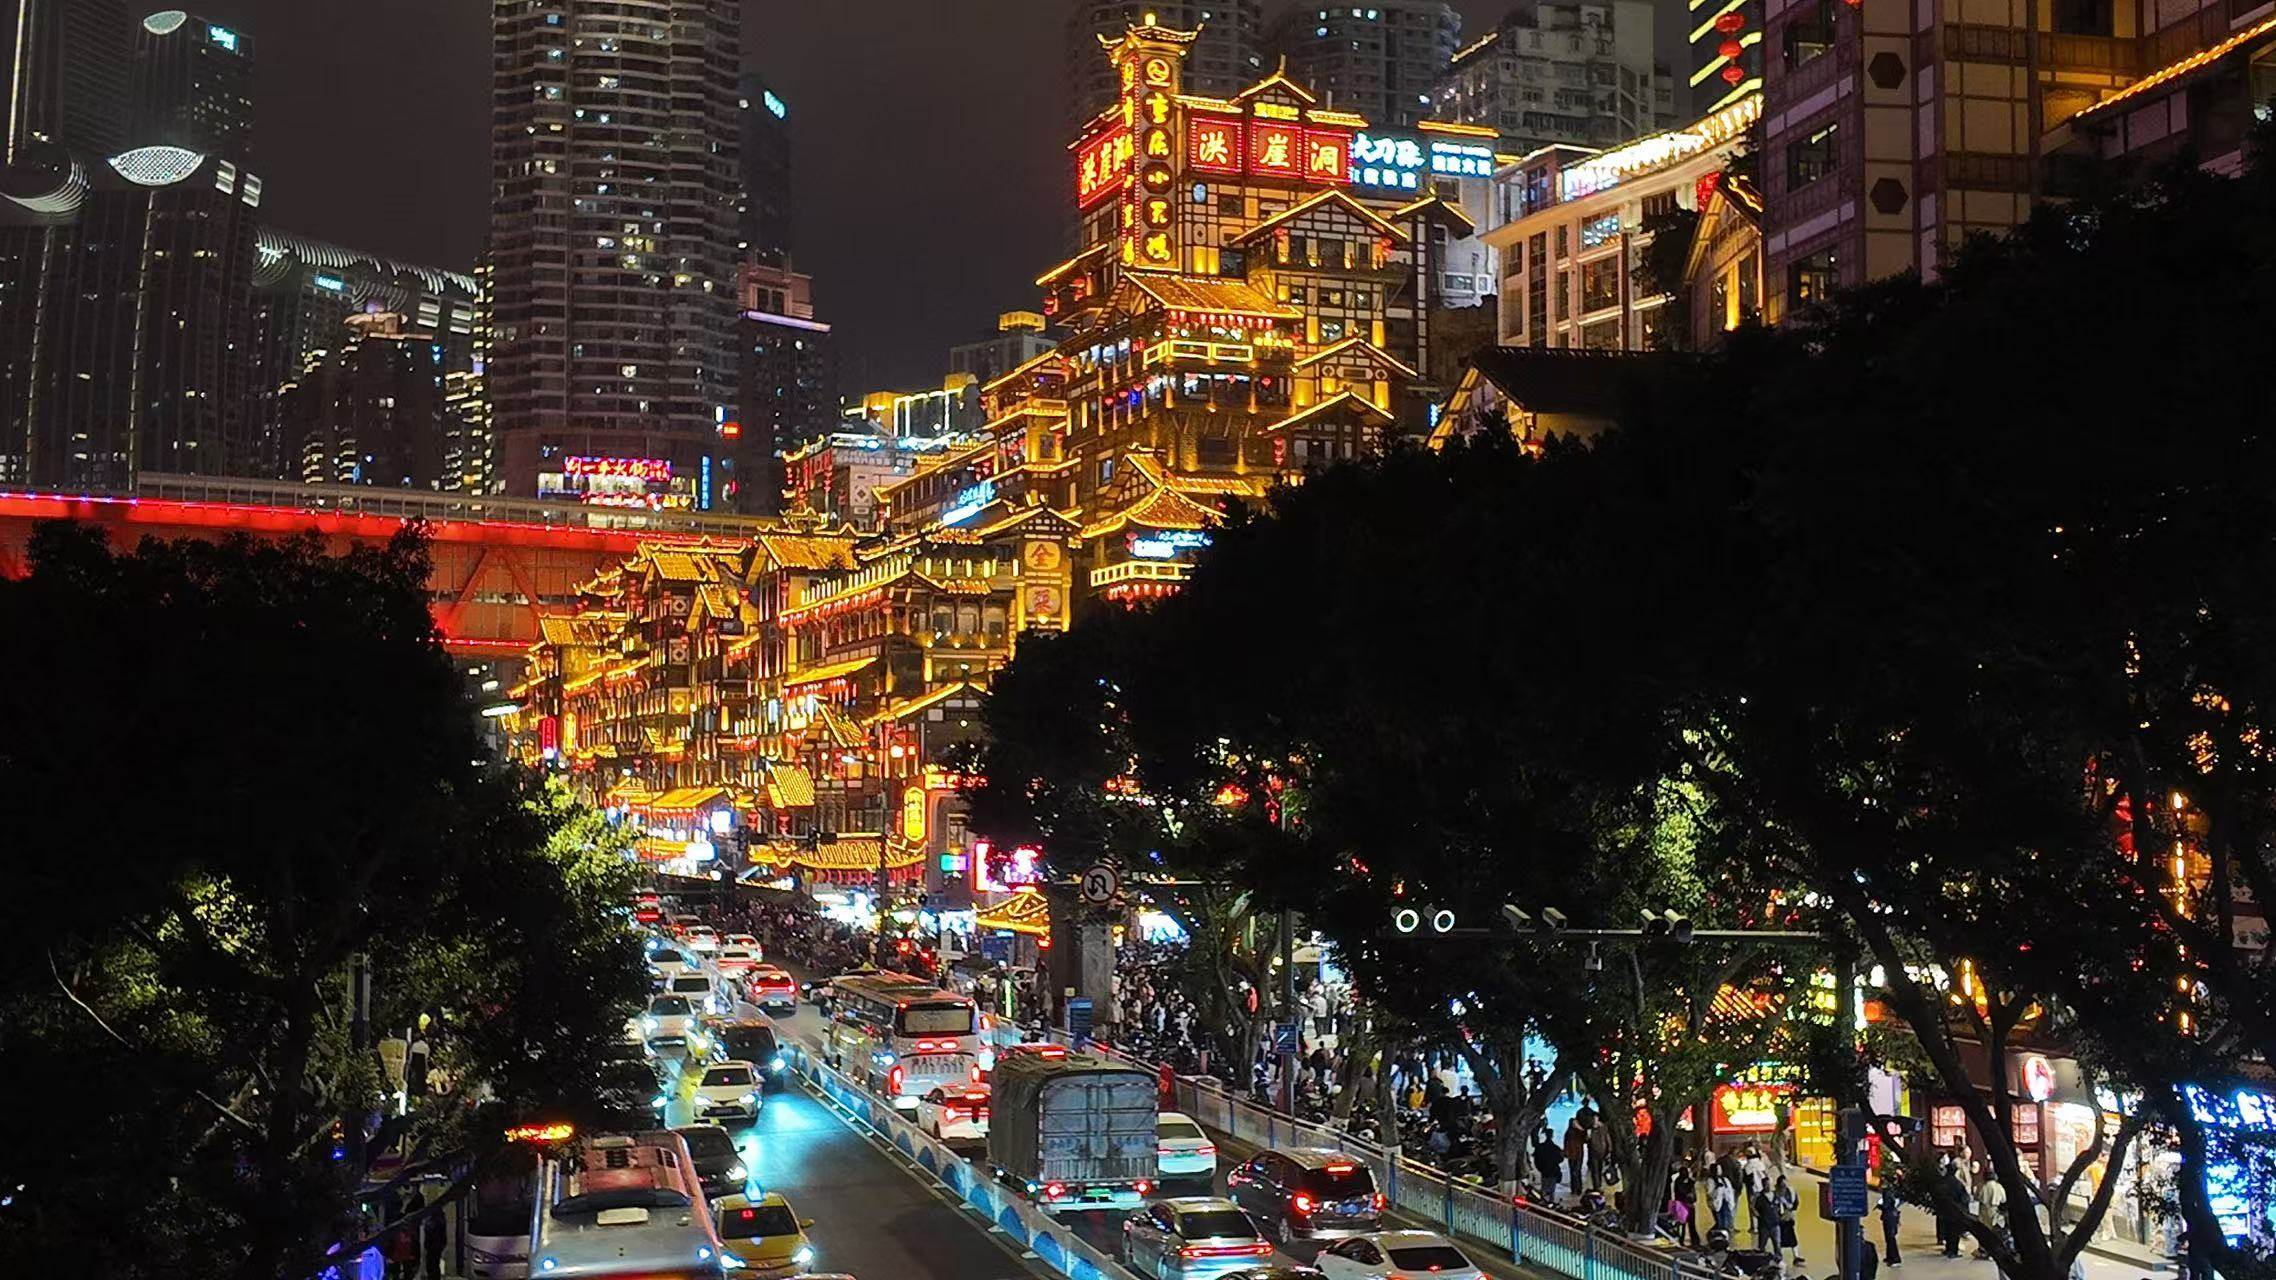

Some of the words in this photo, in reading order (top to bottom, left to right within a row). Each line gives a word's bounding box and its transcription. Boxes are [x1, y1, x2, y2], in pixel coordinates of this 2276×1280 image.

[1080, 133, 1125, 196] 洪崖洞
[1199, 130, 1340, 177] 洪崖洞
